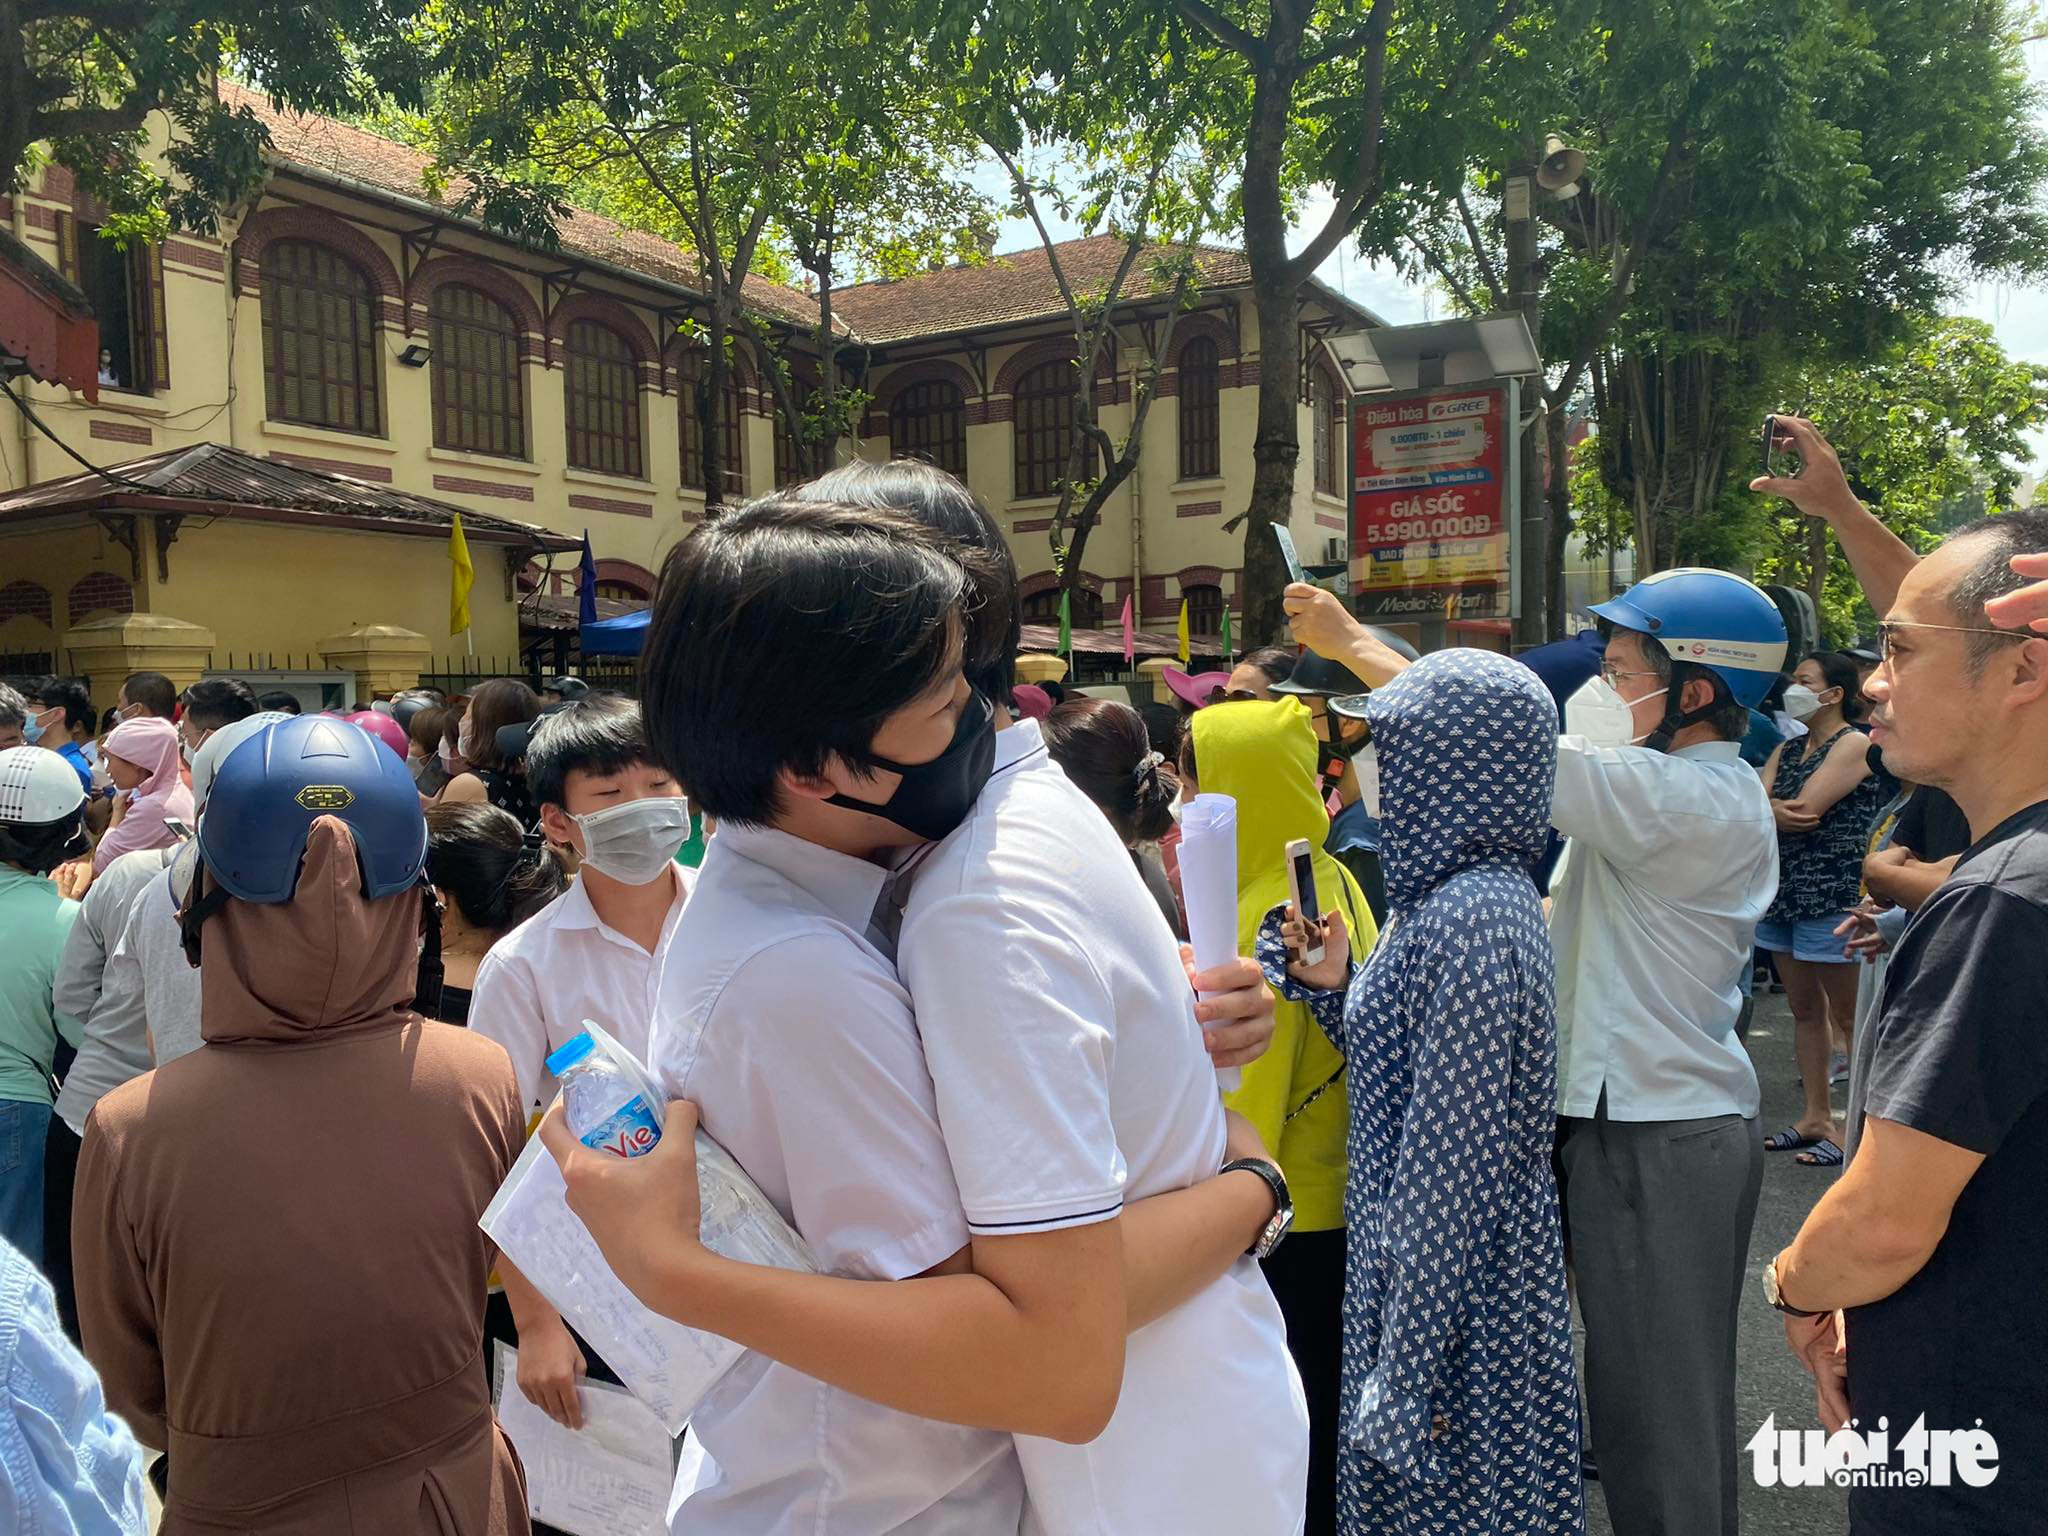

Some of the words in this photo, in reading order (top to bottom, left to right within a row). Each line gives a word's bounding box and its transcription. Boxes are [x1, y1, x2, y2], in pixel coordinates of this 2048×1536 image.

[1367, 408, 1396, 425] Điều
[1399, 407, 1424, 421] hòa
[1447, 400, 1485, 414] GREE
[1390, 495, 1423, 518] GIÁ
[1425, 489, 1465, 515] SỐC
[1367, 515, 1491, 543] 5.990.000Đ
[1380, 549, 1397, 560] BAO
[1376, 596, 1427, 614] Media
[603, 1127, 653, 1158] Vie
